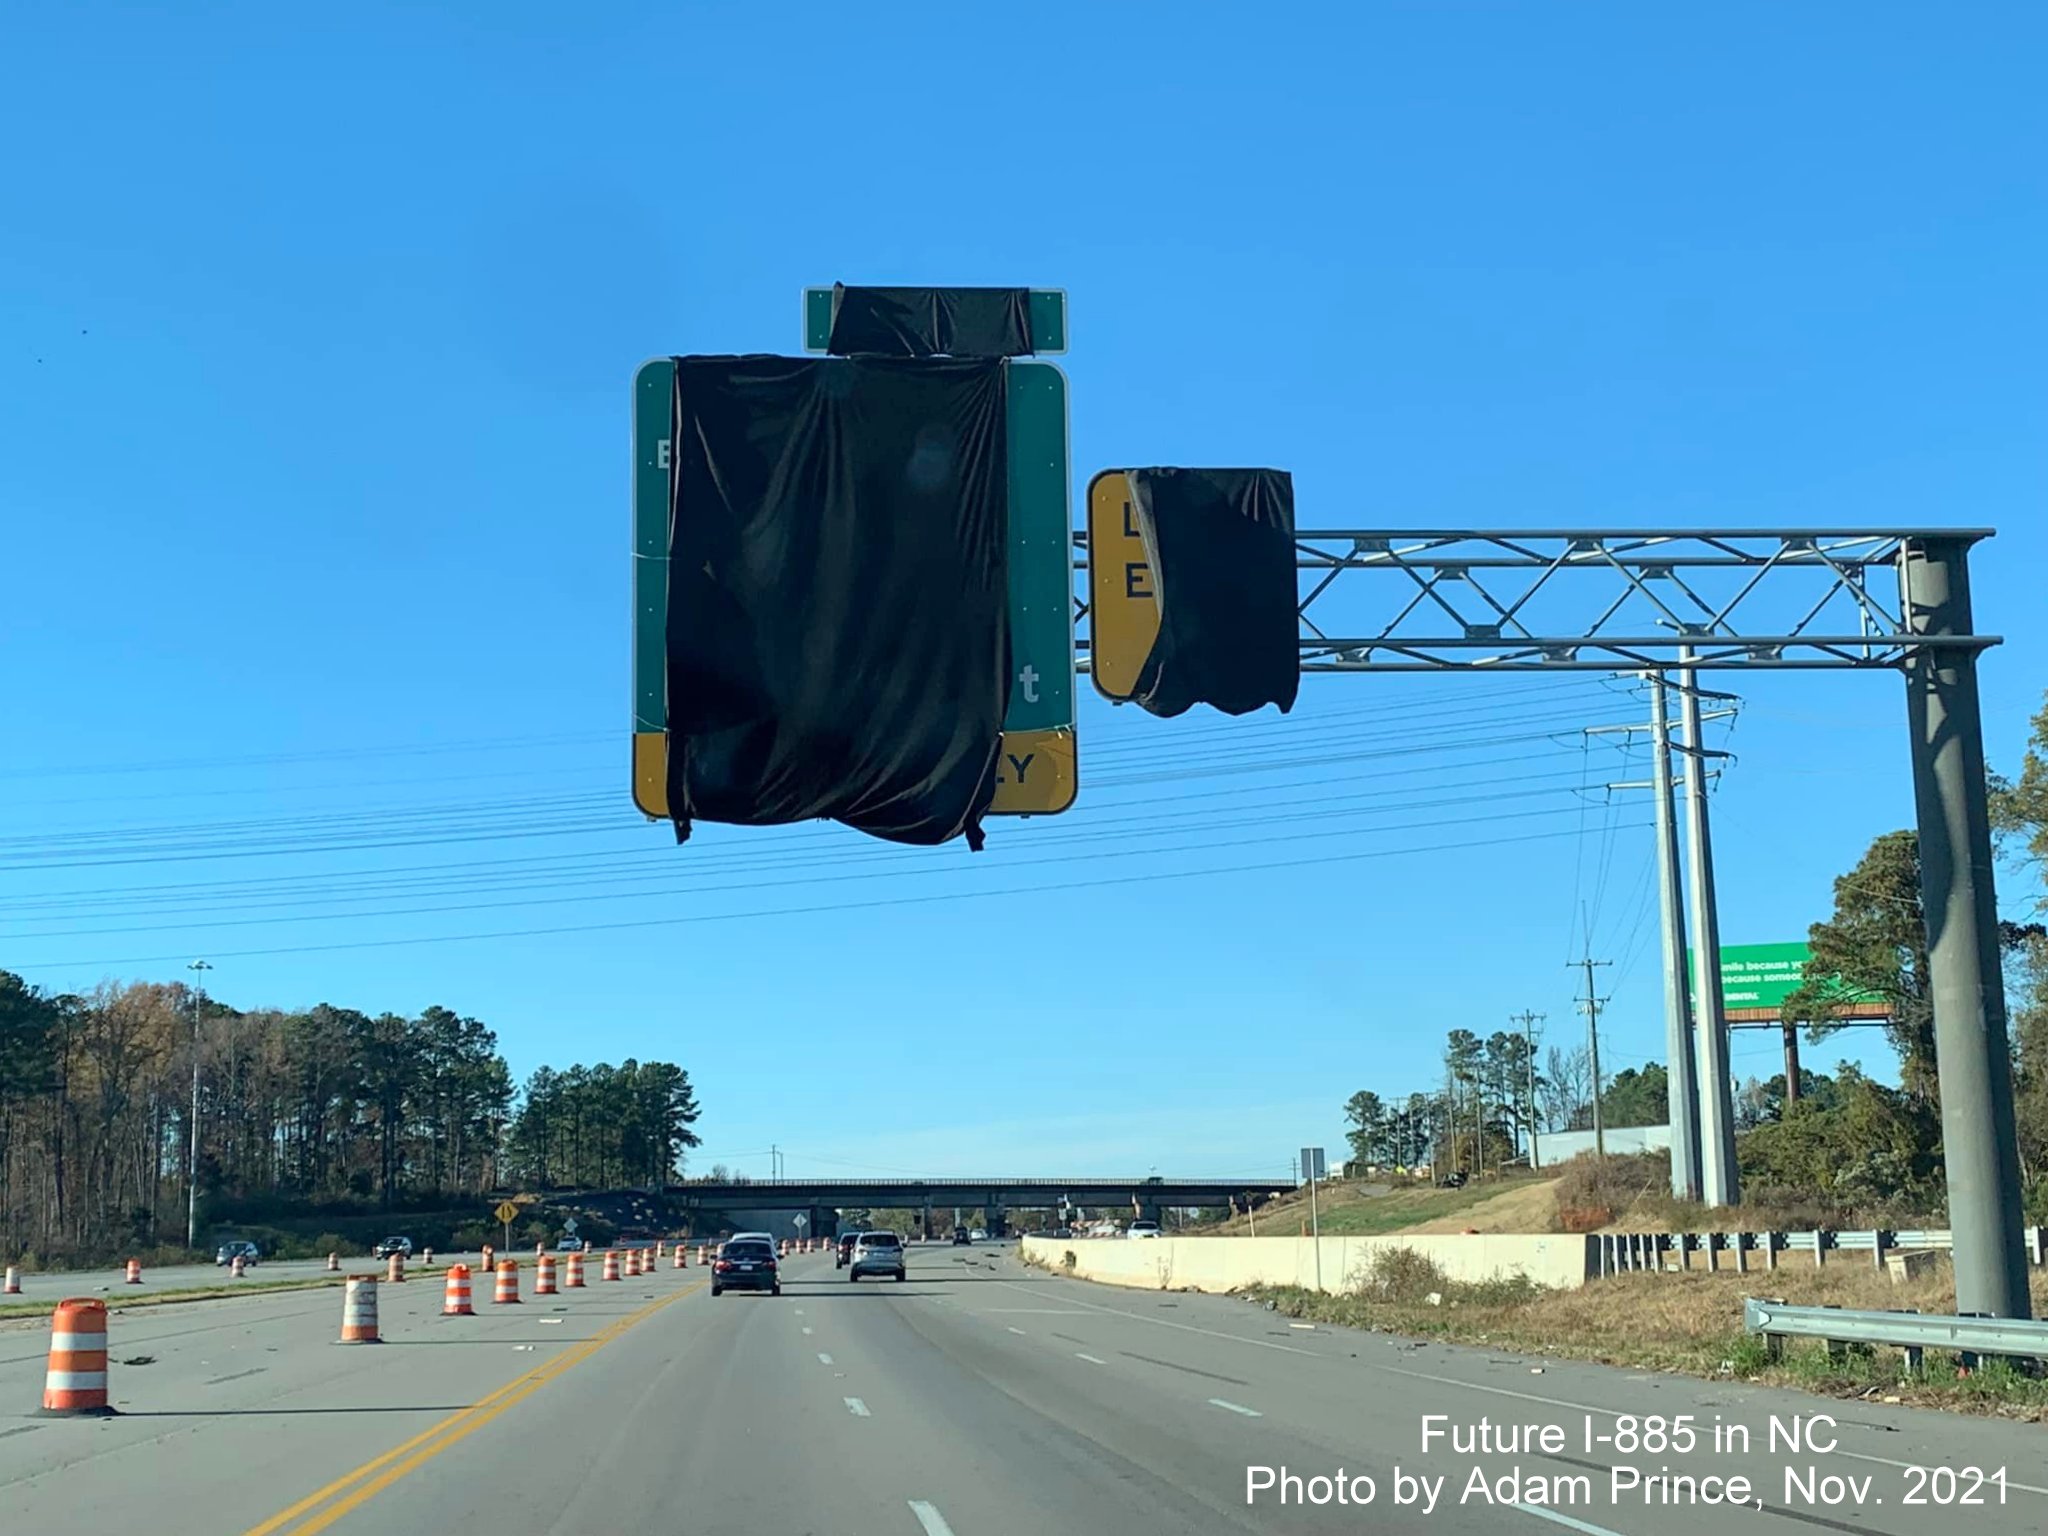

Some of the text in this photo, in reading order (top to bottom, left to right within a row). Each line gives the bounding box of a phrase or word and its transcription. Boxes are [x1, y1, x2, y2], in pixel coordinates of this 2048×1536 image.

[1123, 501, 1141, 538] L
[1126, 562, 1153, 598] E
[1018, 664, 1039, 703] t
[1722, 960, 1803, 972] mile because yo
